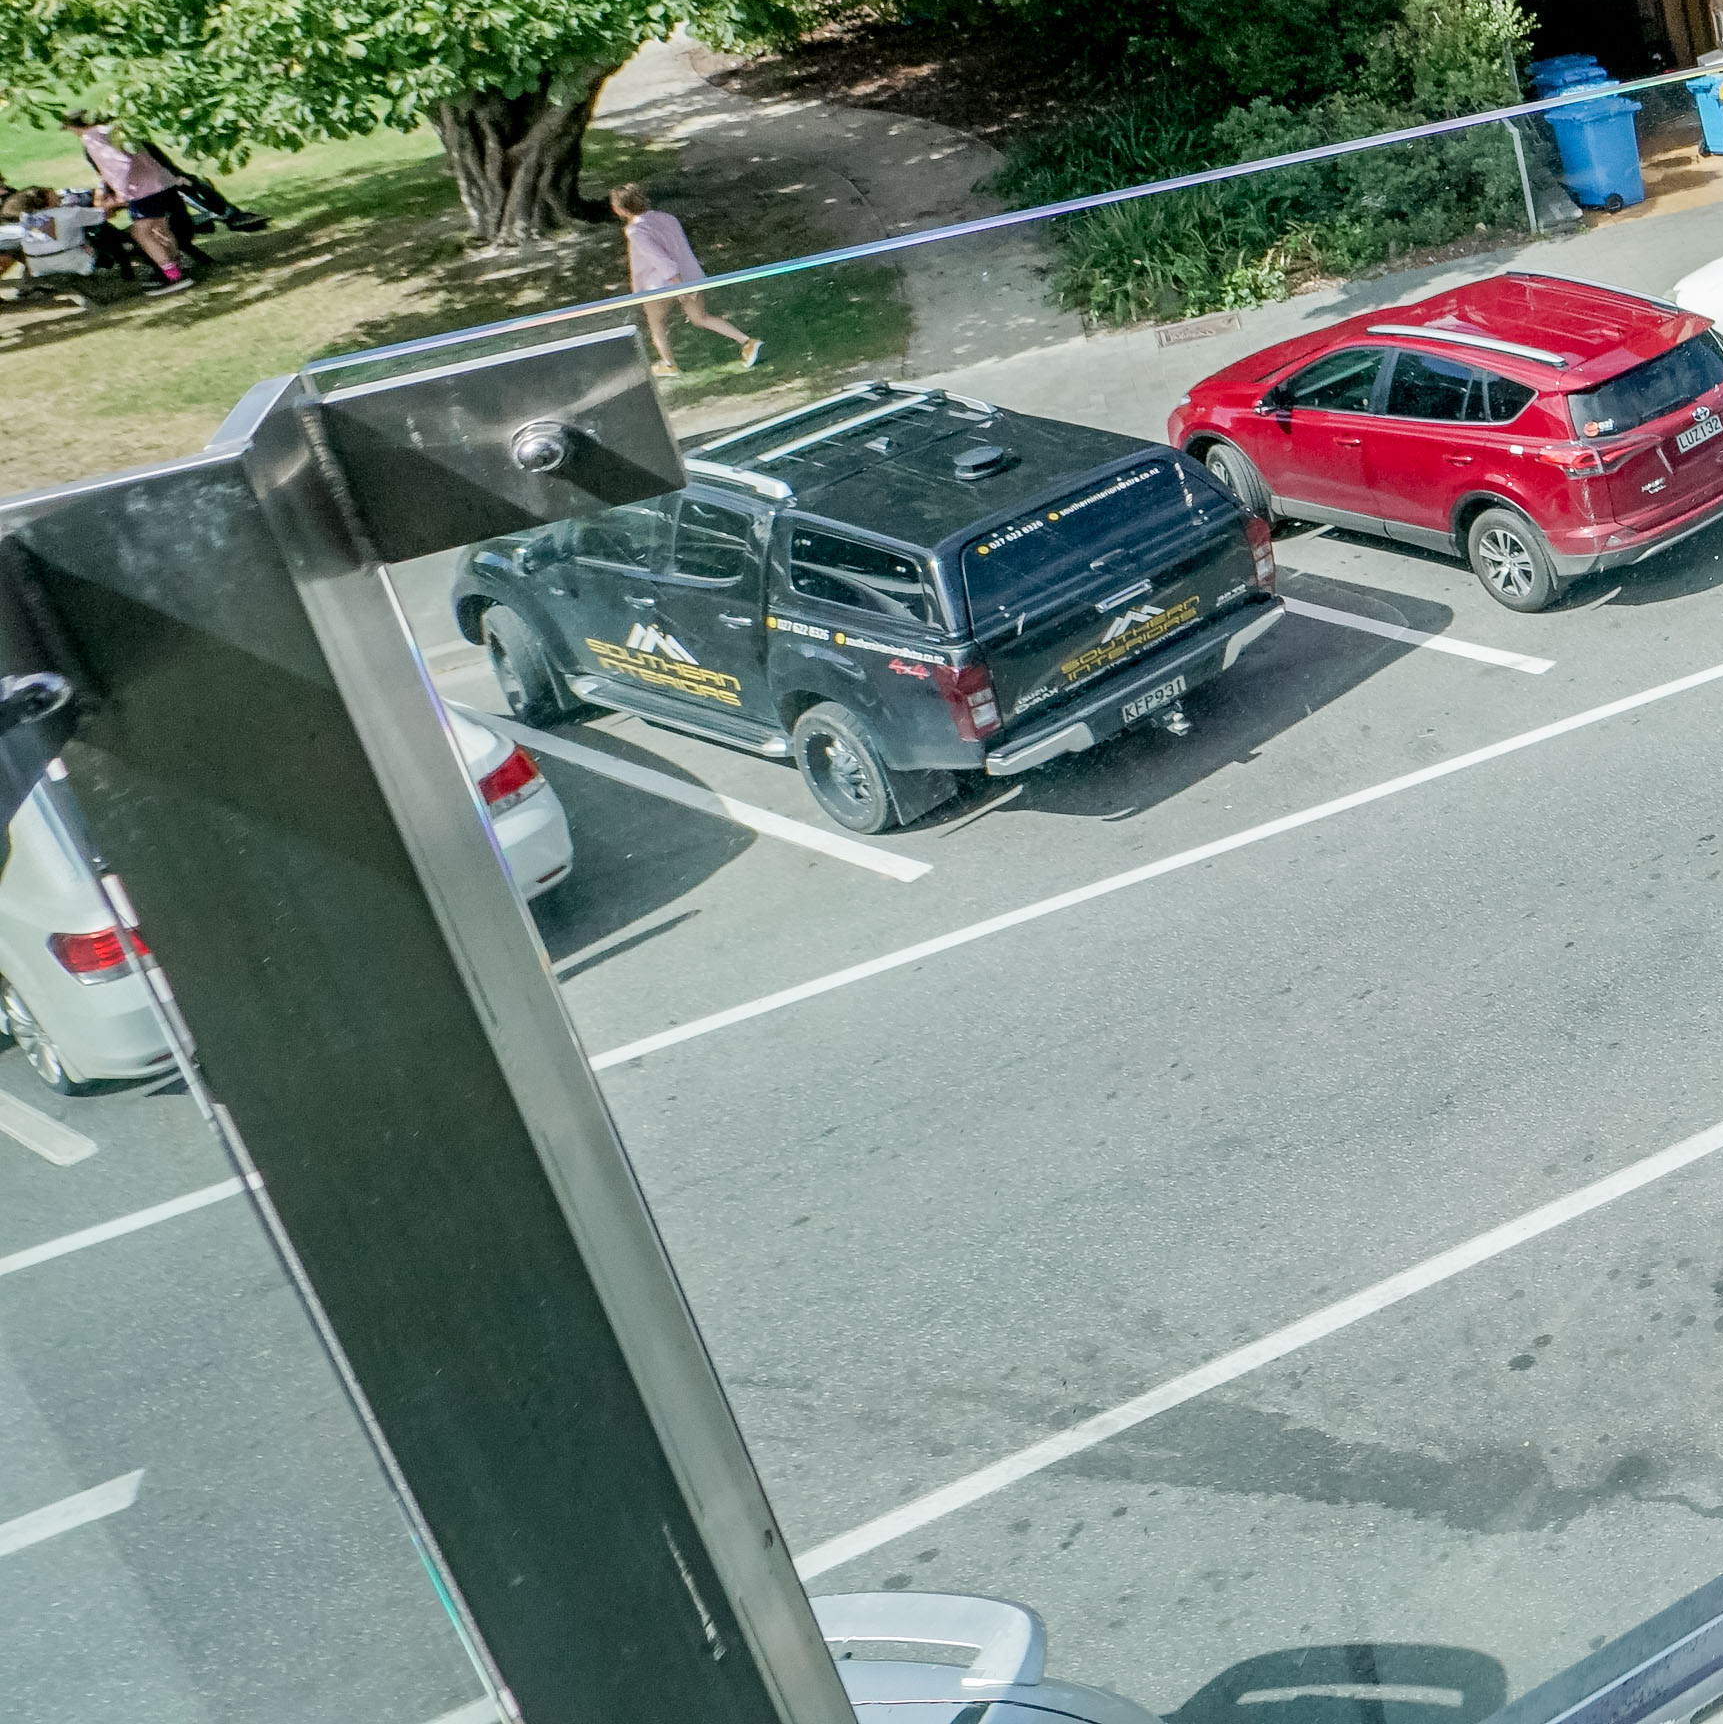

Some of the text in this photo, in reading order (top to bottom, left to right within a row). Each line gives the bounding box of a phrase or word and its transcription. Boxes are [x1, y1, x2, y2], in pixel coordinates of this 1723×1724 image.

[1678, 417, 1721, 449] LUZ132
[1060, 595, 1201, 674] SOUTHERN
[1069, 607, 1198, 681] INTERIORS
[584, 636, 743, 692] SOUTHERN
[598, 656, 742, 707] INTERIORS
[1123, 677, 1185, 722] KFP931
